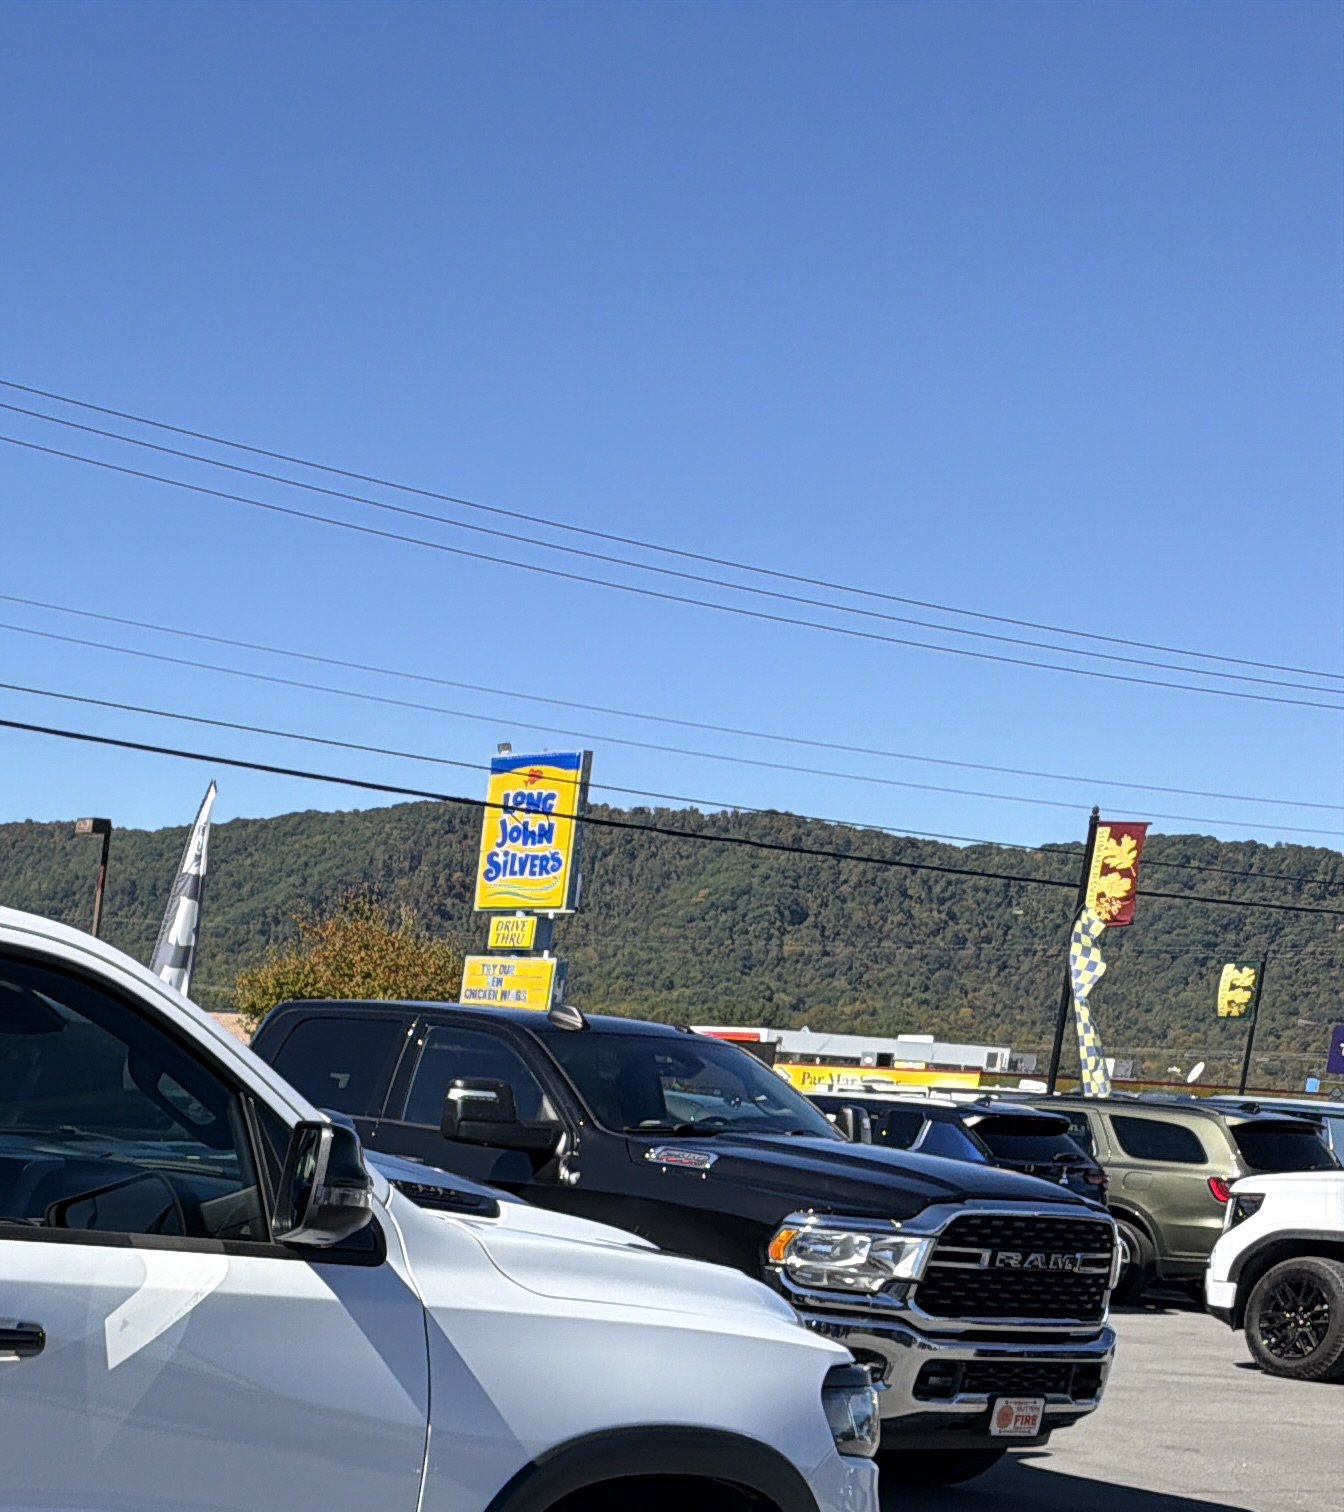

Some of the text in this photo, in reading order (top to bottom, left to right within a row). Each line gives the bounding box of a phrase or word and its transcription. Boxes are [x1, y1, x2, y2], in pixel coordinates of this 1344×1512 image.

[503, 791, 557, 815] LONG
[496, 920, 528, 932] DRIVE
[495, 933, 525, 945] THRU
[487, 976, 504, 988] EW
[500, 989, 528, 1002] WIGS
[996, 1251, 1076, 1271] RAM
[1013, 1414, 1039, 1426] FIRE
